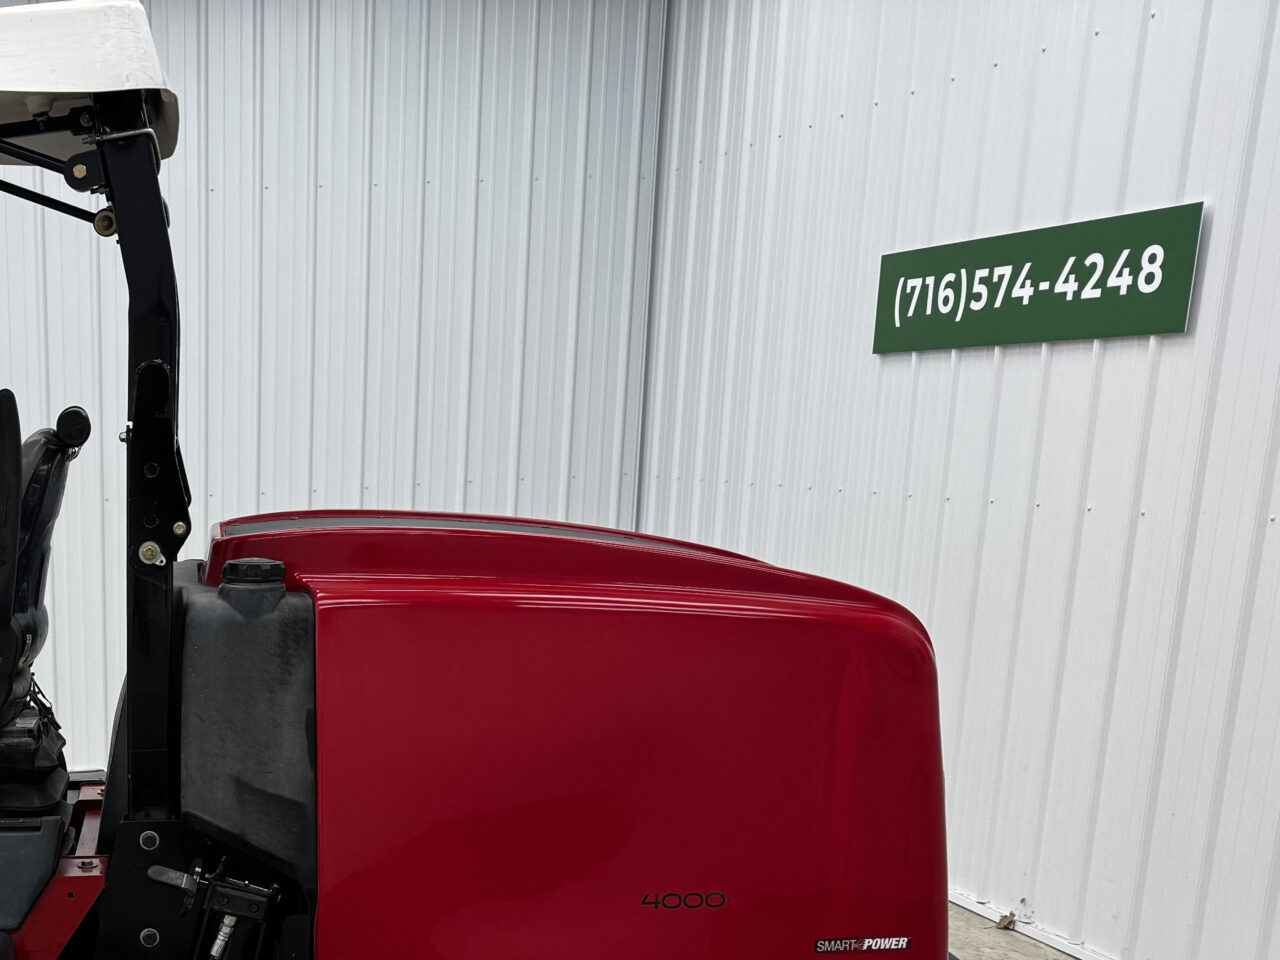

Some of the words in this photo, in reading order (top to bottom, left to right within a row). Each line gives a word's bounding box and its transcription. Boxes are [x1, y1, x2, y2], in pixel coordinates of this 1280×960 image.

[894, 244, 1165, 328] (716)574-4248
[640, 892, 726, 910] 4000
[816, 939, 858, 952] SMART
[863, 937, 908, 950] POWER
